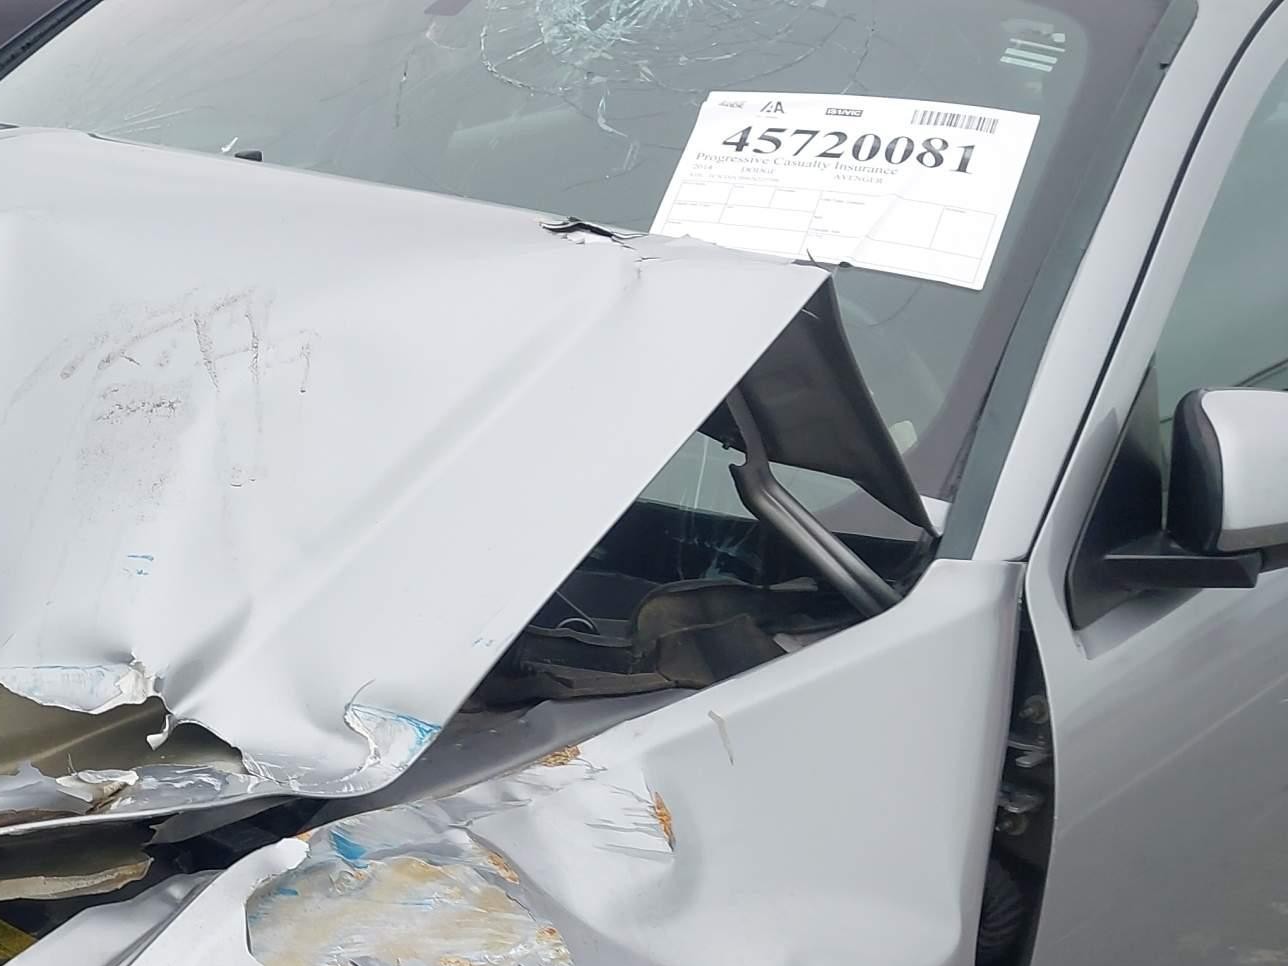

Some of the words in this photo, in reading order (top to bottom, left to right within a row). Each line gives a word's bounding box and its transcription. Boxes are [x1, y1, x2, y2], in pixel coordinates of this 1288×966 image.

[695, 152, 770, 166] Progressive
[773, 158, 828, 171] Casualty
[834, 162, 899, 175] Insurance
[721, 125, 976, 175] 45720081
